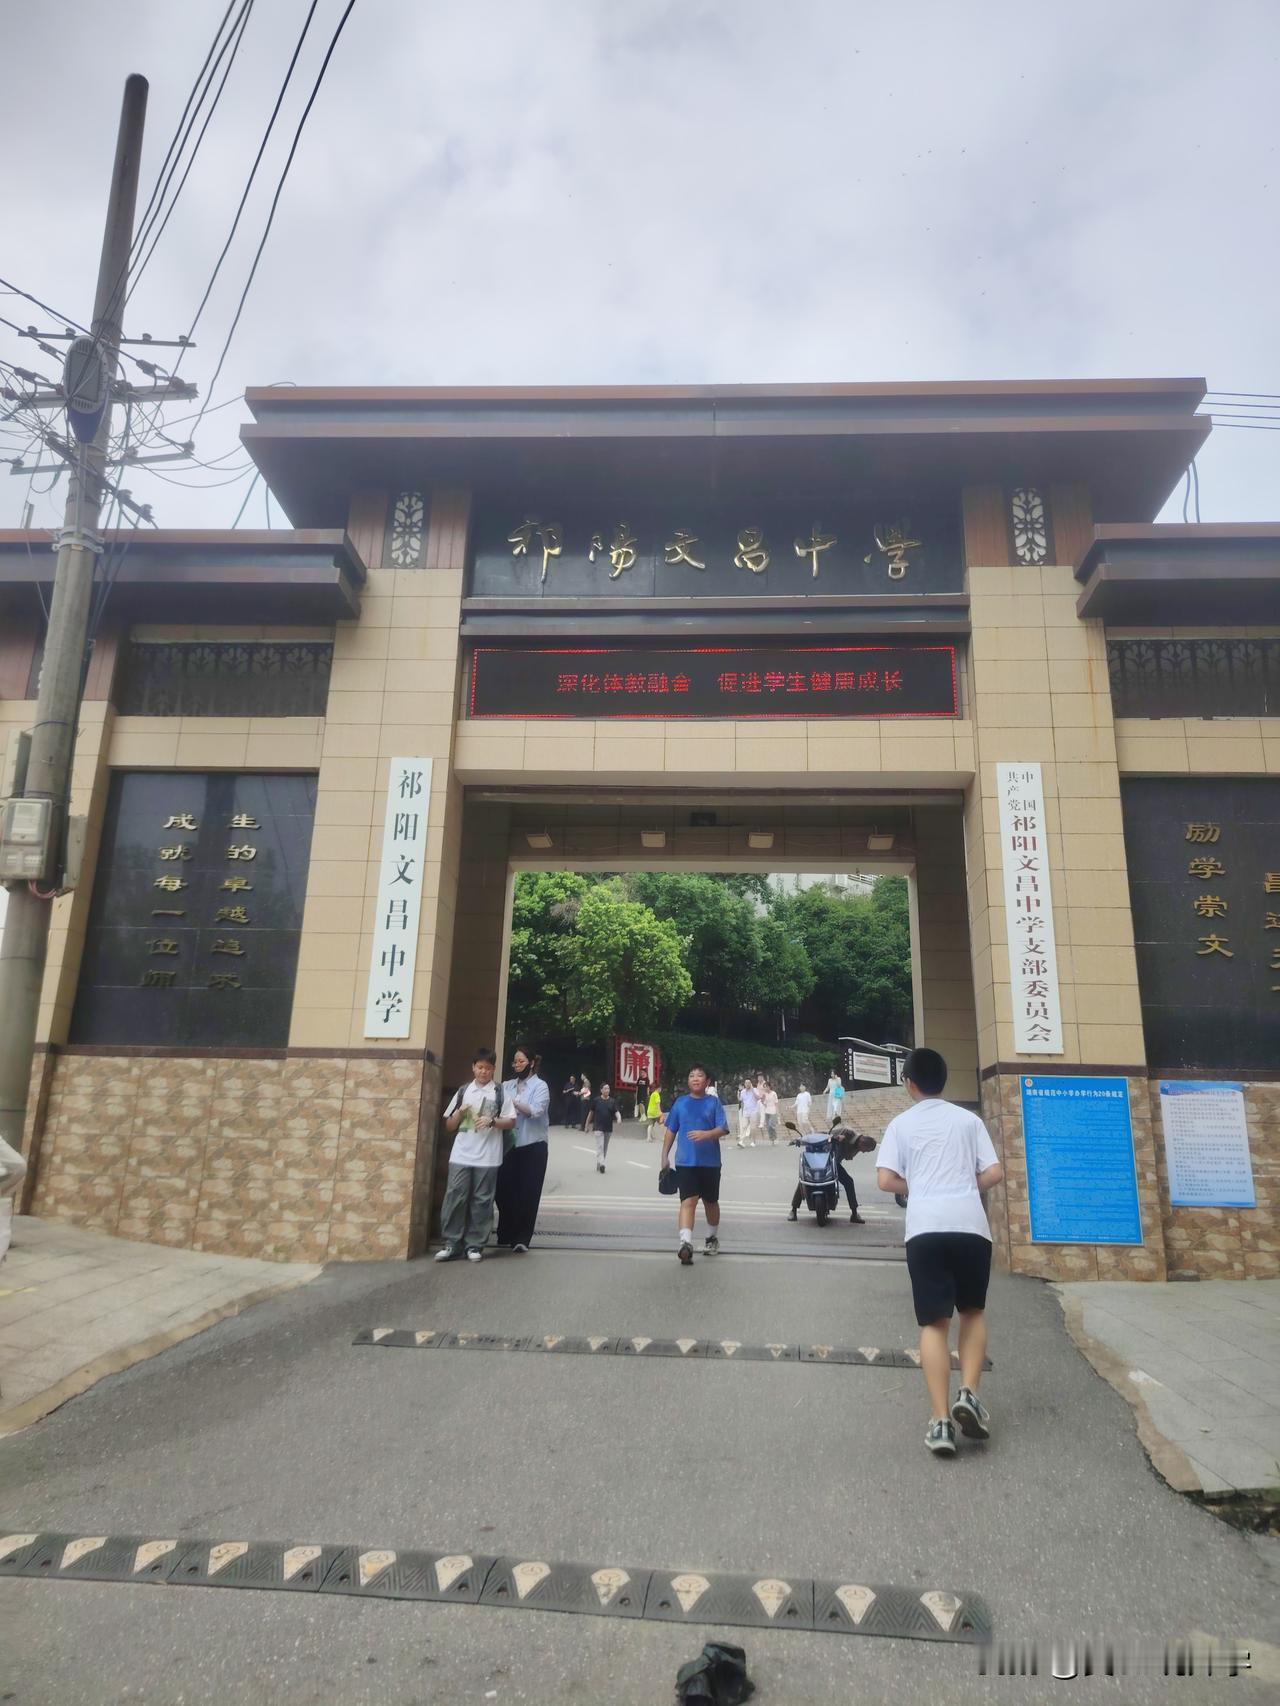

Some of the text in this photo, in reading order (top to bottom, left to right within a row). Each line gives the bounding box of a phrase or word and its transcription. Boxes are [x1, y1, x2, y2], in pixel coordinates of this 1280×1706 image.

[1021, 771, 1036, 811] 中国
[375, 769, 422, 1024] 祁阳文昌中学
[1010, 815, 1052, 1042] 祁阳文昌中学支部委员会
[1185, 823, 1235, 957] 励学崇文
